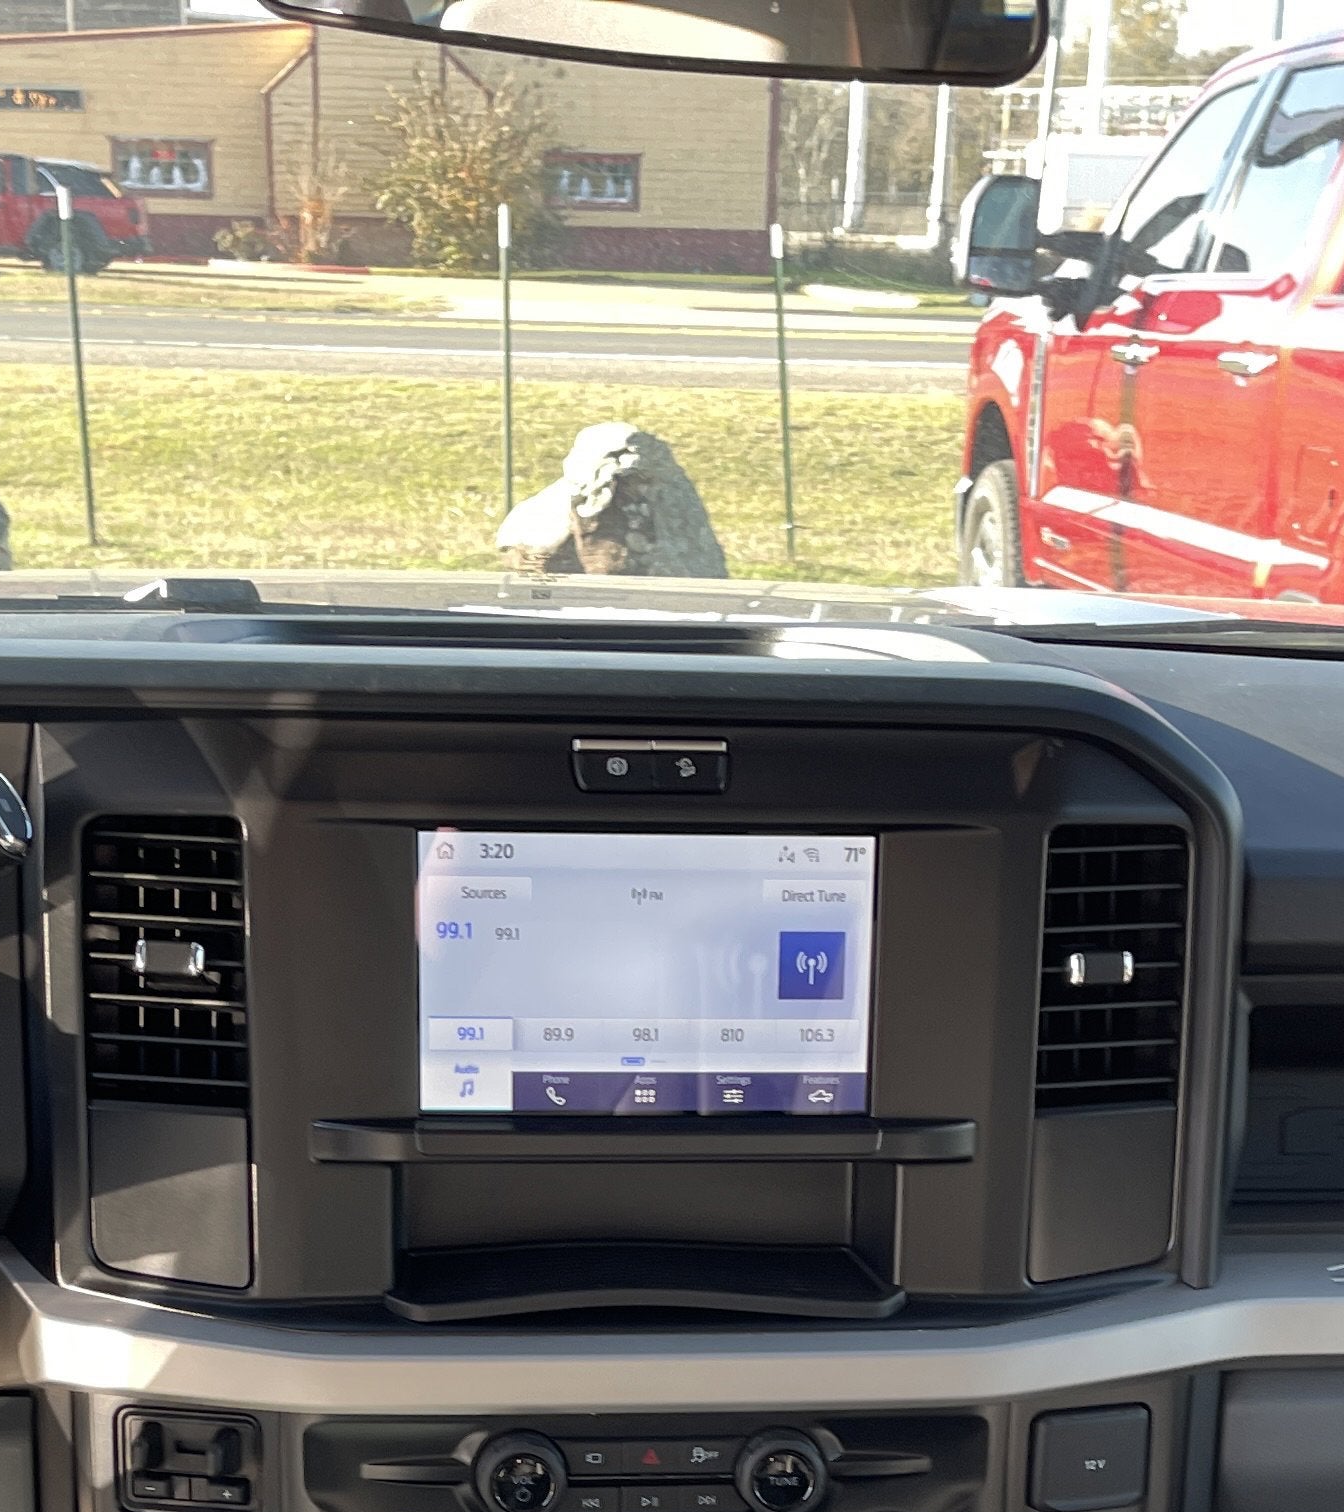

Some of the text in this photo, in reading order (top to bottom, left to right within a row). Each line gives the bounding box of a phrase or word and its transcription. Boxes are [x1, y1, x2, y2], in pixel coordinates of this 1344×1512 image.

[478, 842, 515, 860] 3:20
[460, 886, 507, 900] Sources
[781, 889, 847, 903] Direct Tune
[436, 921, 473, 940] 99.1
[494, 927, 521, 941] 99.1
[456, 1026, 485, 1041] 99.1
[542, 1026, 575, 1042] 89.9
[632, 1027, 660, 1042] 98.1
[720, 1027, 745, 1043] 810
[799, 1027, 836, 1043] 106.3
[542, 1074, 571, 1085] Phone
[716, 1074, 752, 1086] Settings
[802, 1074, 841, 1085] Features
